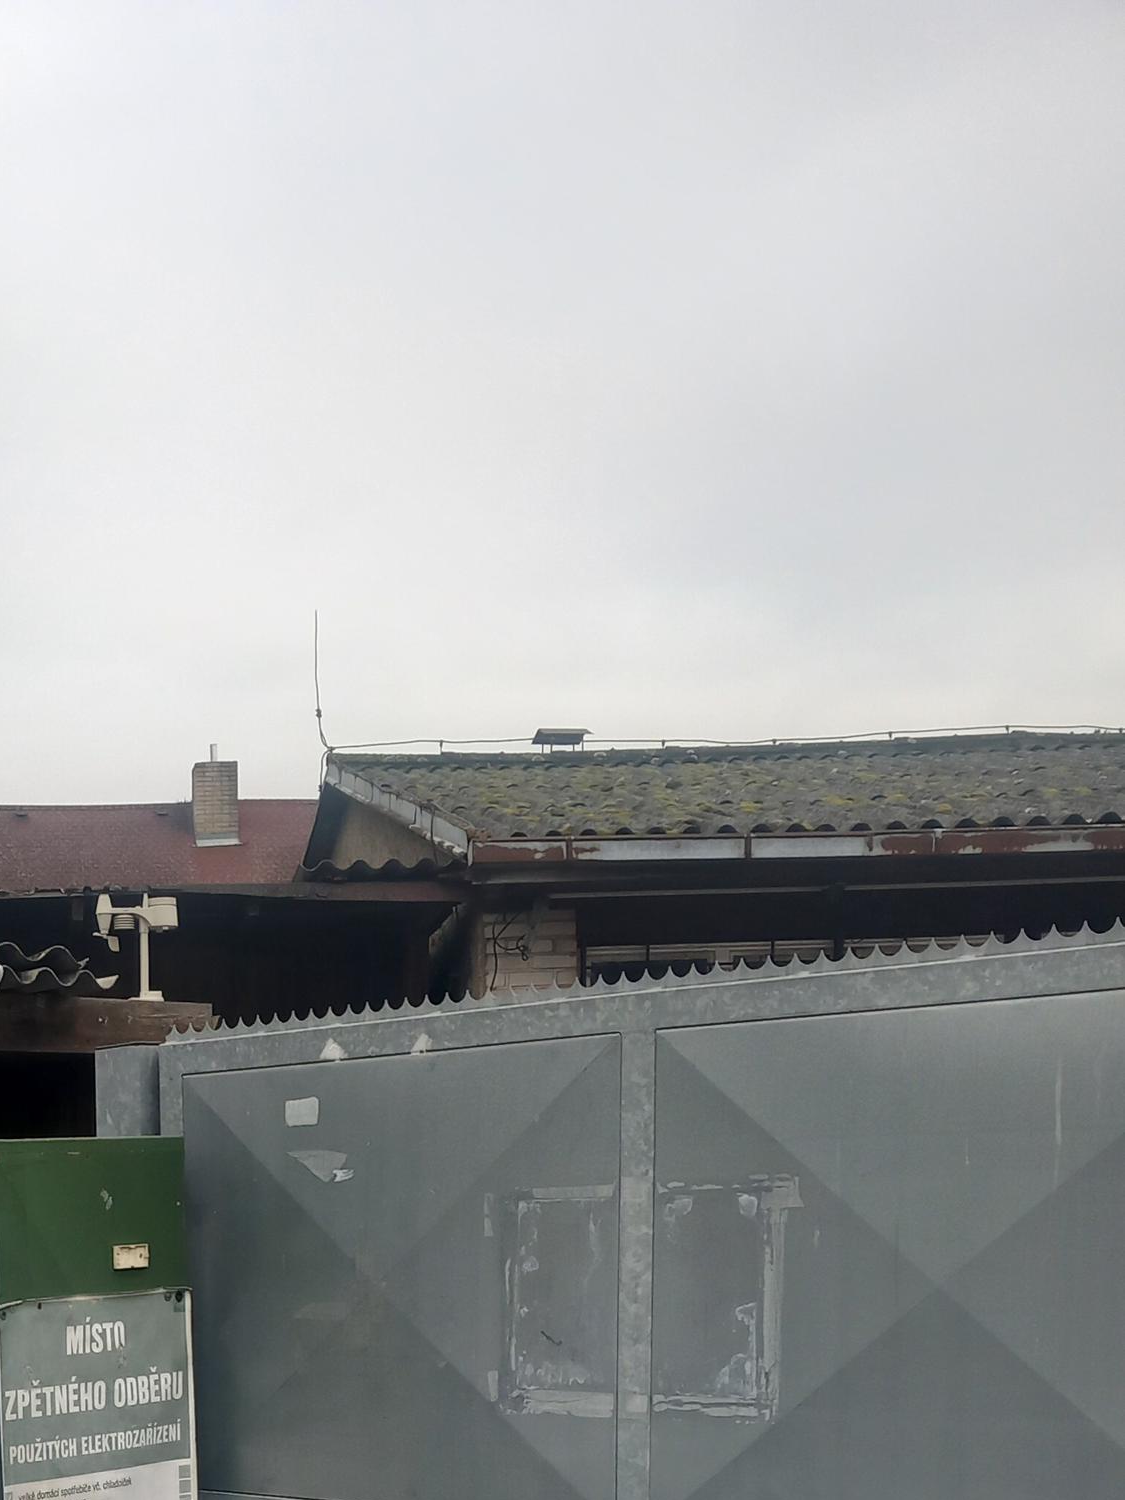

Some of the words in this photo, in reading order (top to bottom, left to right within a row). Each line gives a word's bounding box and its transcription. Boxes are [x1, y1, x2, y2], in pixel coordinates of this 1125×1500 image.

[66, 1316, 125, 1355] MÍSTO
[4, 1375, 107, 1421] ZPĚTNÉHO
[113, 1366, 184, 1408] ODBĚRU
[9, 1435, 77, 1465] POUŽITÝCH
[81, 1419, 182, 1455] ELEKTROZAŘÍZENÍ
[37, 1489, 59, 1500] domácí
[61, 1485, 91, 1498] spotřebiče
